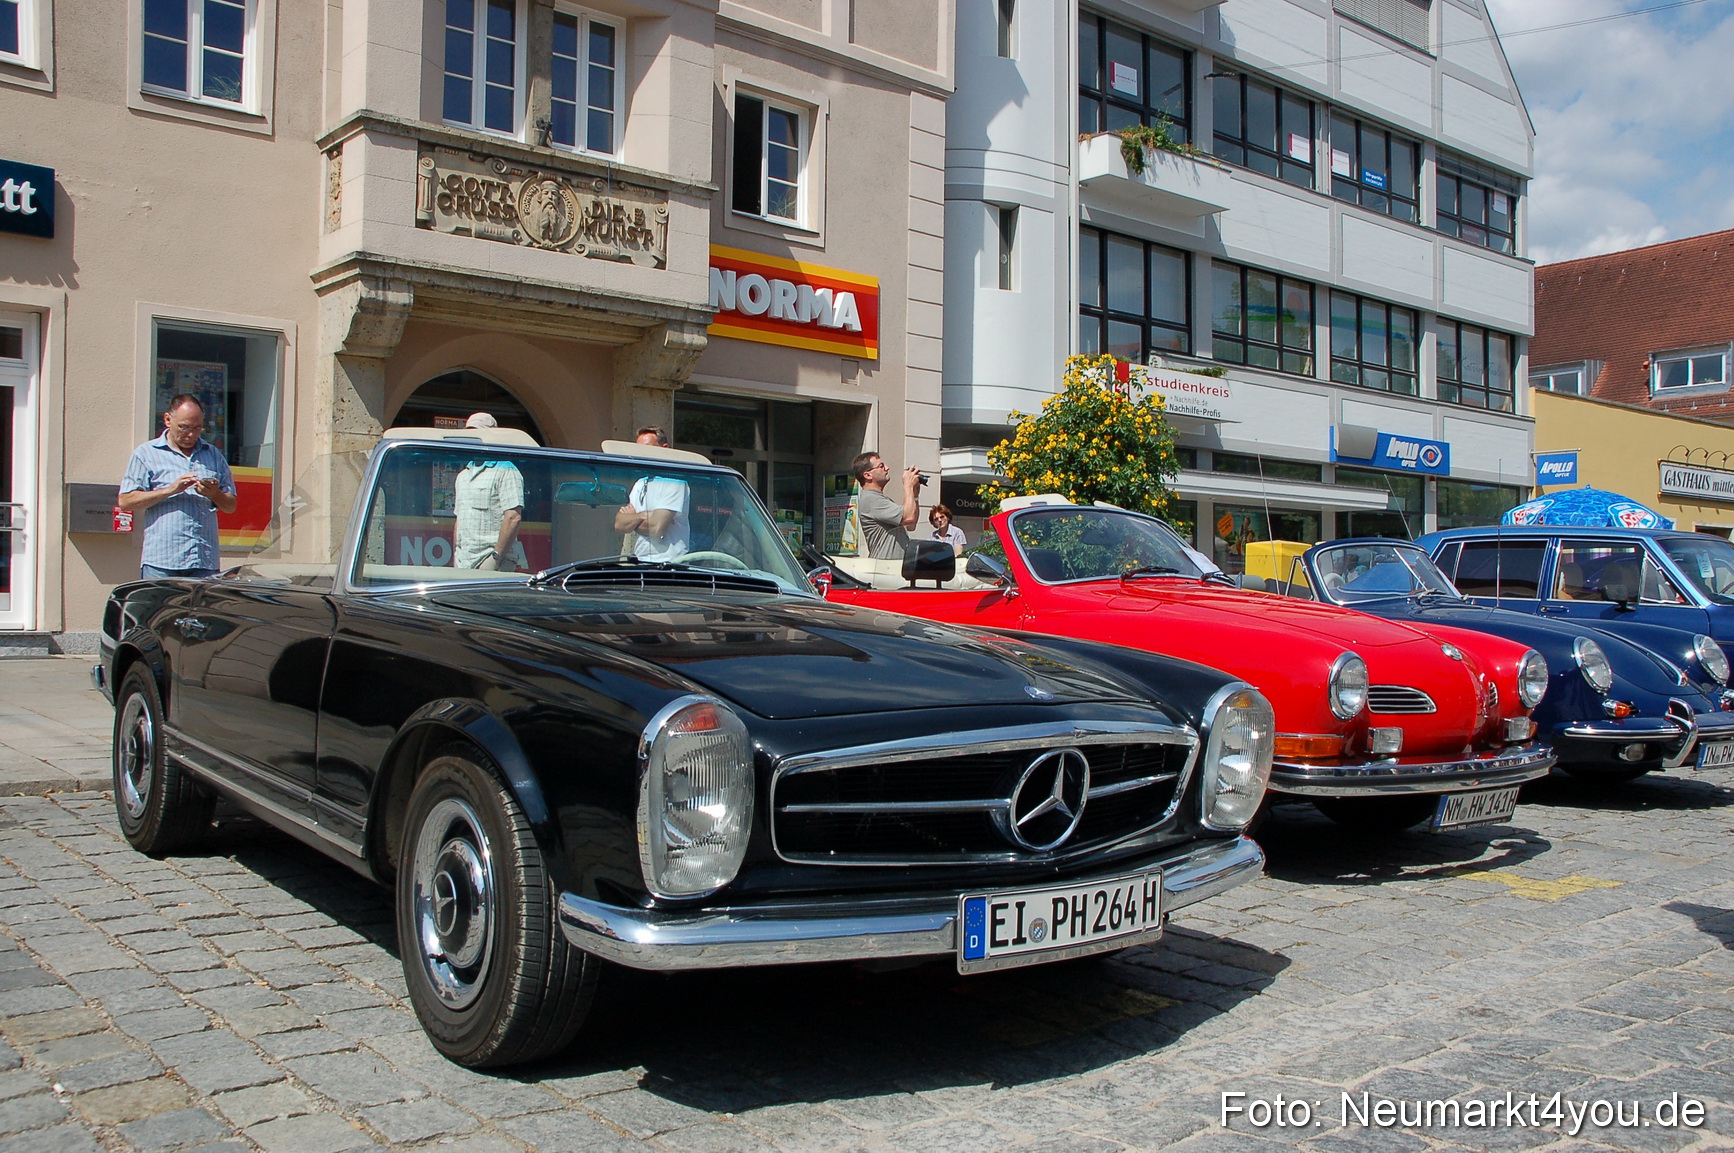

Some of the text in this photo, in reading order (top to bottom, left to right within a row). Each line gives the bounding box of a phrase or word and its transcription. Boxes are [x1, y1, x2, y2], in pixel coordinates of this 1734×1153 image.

[0, 178, 37, 215] tt
[709, 267, 863, 332] NORMA
[1147, 376, 1230, 398] studienkreis
[1169, 404, 1221, 418] Nachhilfe-Profis
[435, 419, 458, 427] NORMA
[1386, 436, 1420, 461] APOLLO
[1539, 461, 1574, 475] APOLLO
[1664, 469, 1734, 495] GASTHAUS mittle
[826, 542, 840, 552] 2012
[1703, 746, 1717, 764] IN
[1442, 797, 1464, 822] NM
[1485, 789, 1518, 815] 141H
[990, 900, 1027, 948] EI
[1051, 893, 1088, 940] PH
[969, 935, 978, 949] D
